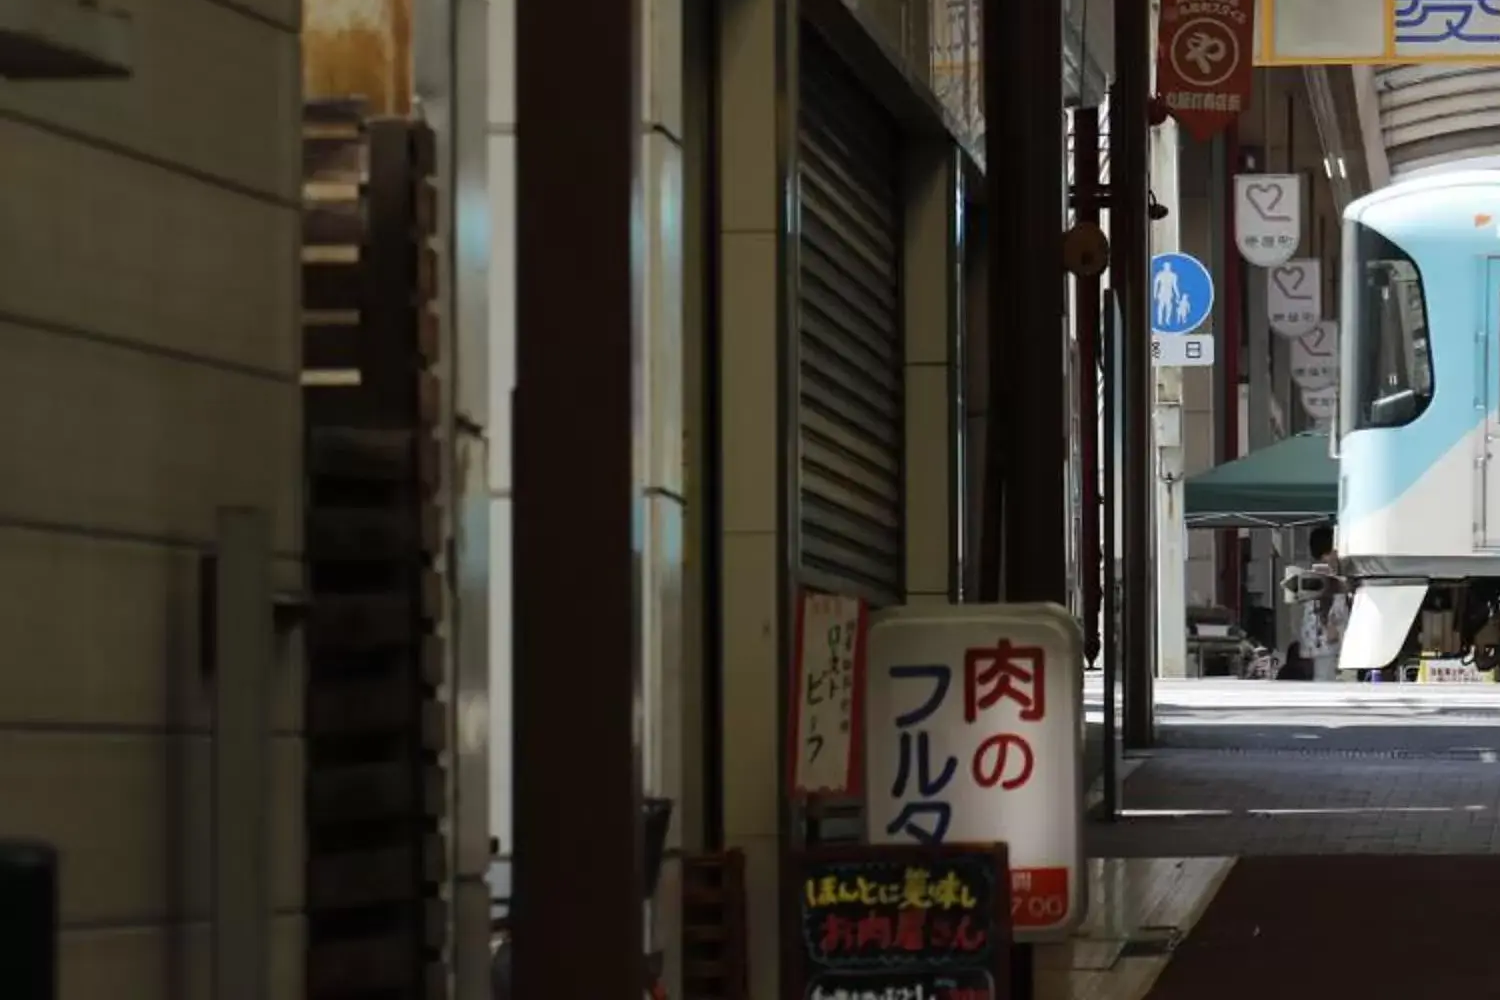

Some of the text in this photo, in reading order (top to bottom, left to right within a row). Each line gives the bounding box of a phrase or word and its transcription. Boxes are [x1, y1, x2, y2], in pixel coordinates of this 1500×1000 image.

[886, 664, 958, 843] フルタ
[964, 638, 1046, 791] 肉の
